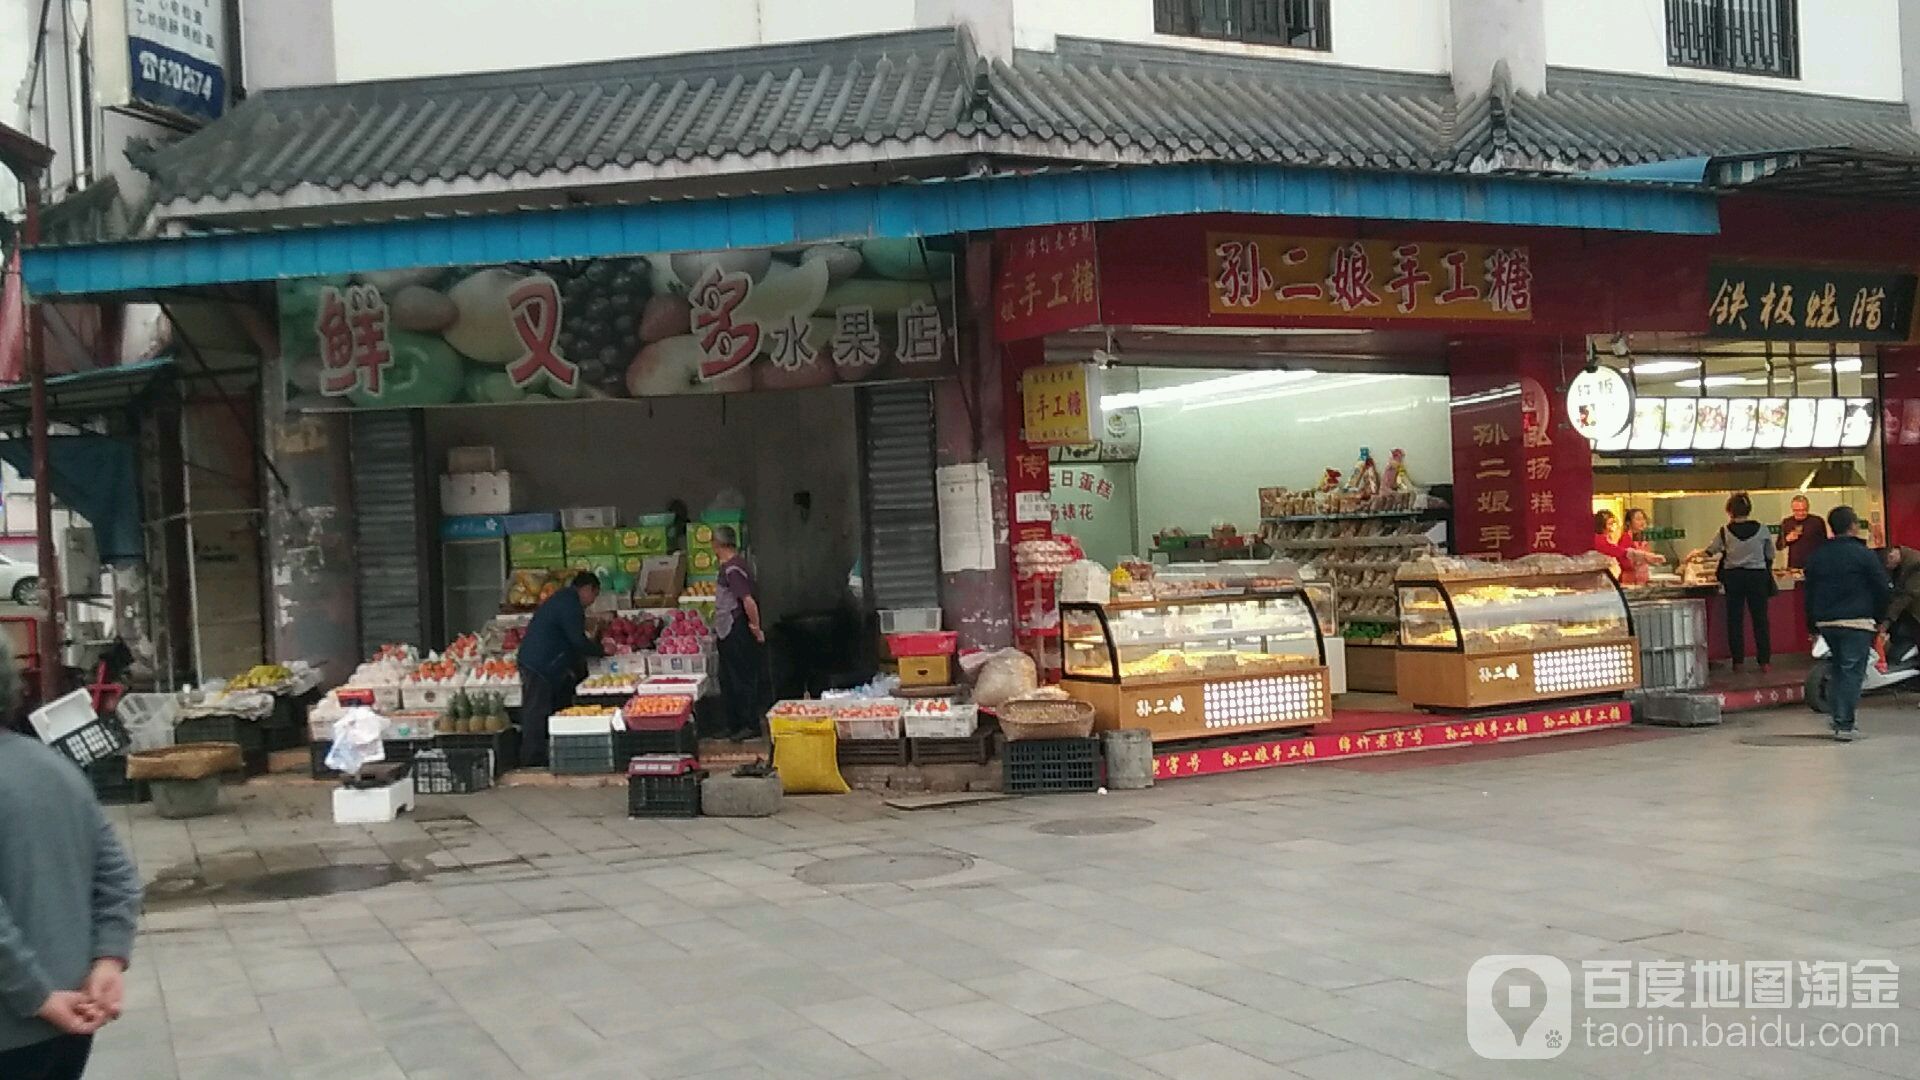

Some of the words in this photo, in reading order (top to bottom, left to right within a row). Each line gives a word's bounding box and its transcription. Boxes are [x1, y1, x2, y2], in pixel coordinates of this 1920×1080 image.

[1019, 259, 1095, 317] 手工糖
[1216, 243, 1533, 313] 孙二娘手工糖
[769, 303, 942, 368] 水果店
[1036, 390, 1082, 420] 手工糖
